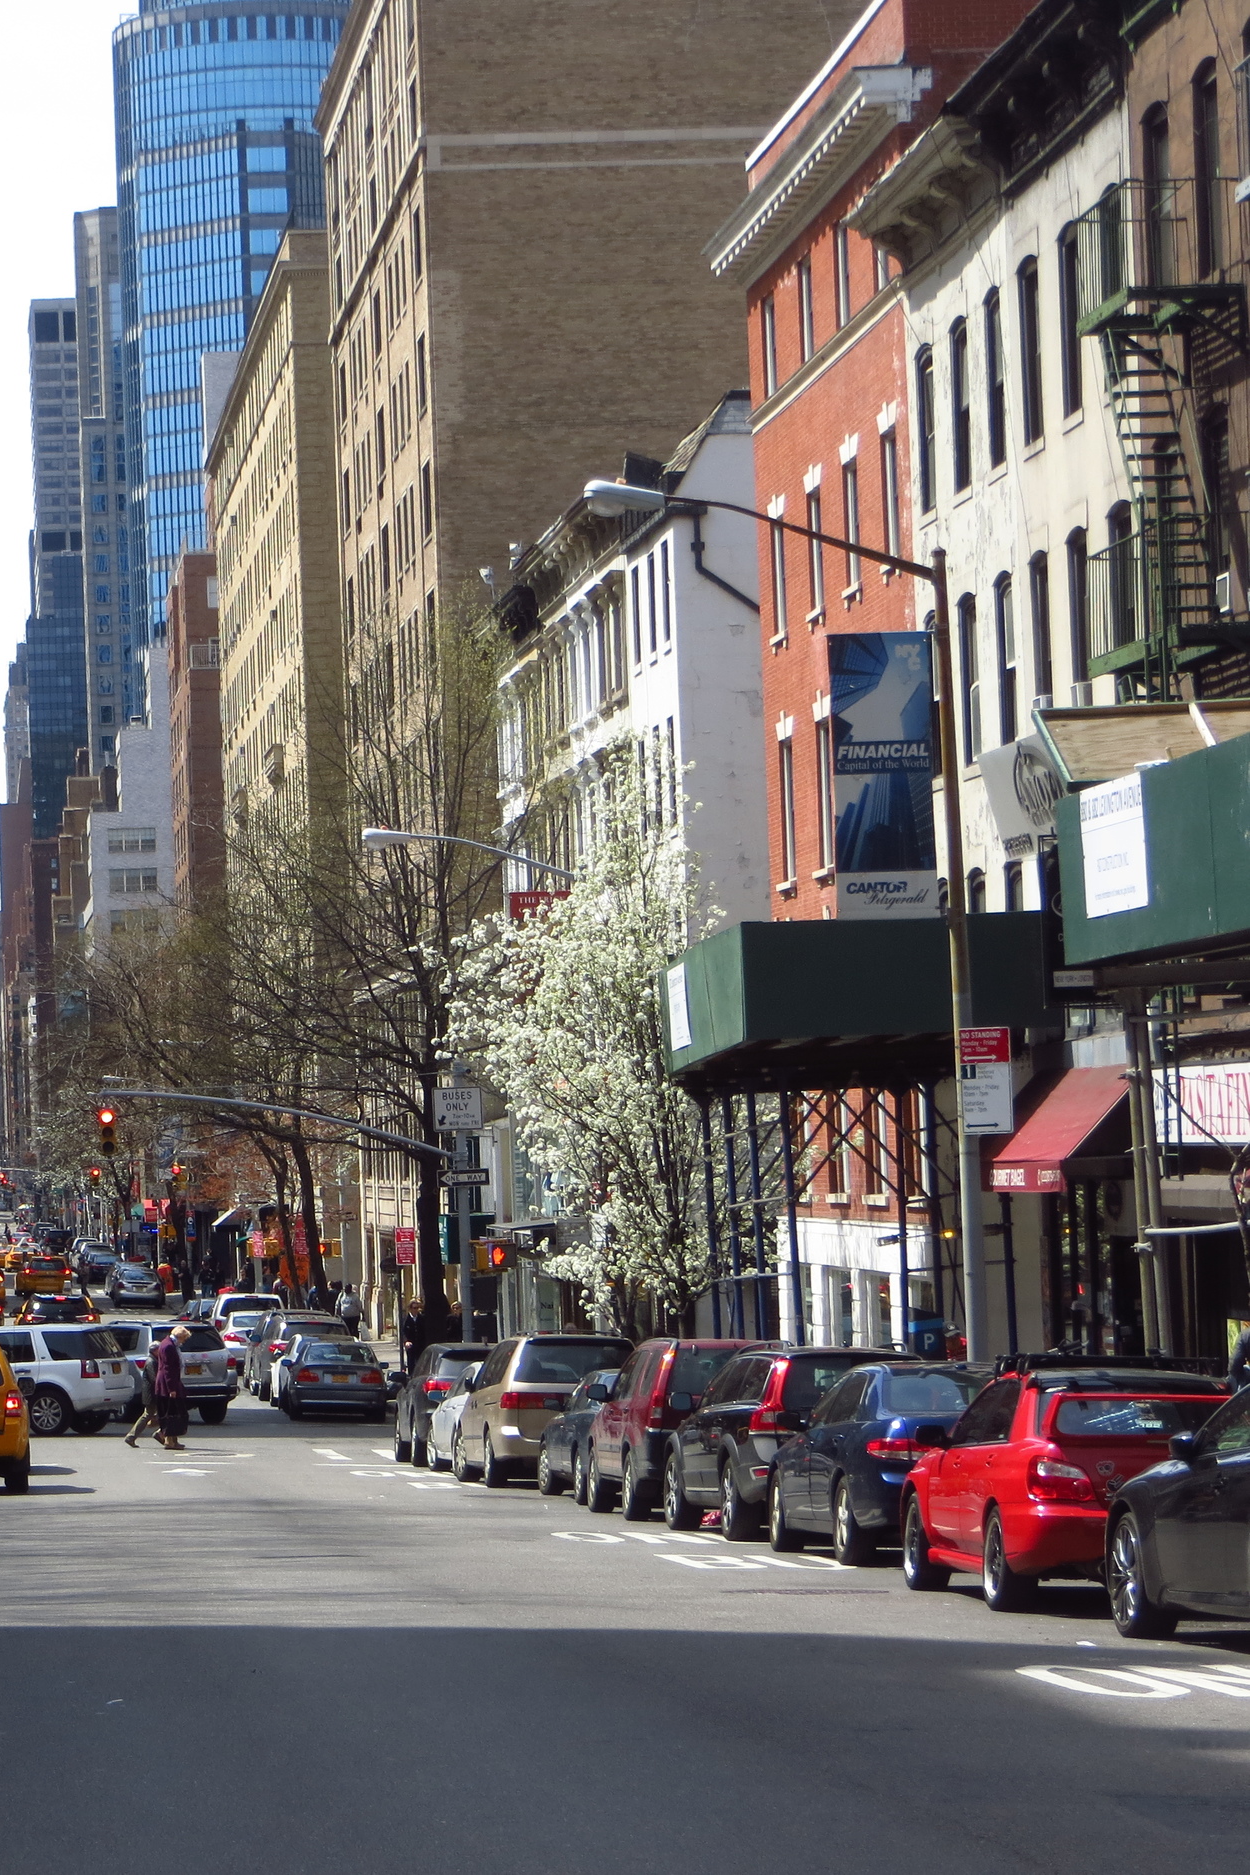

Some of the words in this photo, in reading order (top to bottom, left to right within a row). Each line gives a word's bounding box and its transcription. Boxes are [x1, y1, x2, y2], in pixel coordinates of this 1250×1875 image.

[837, 743, 928, 760] FINANCIAL
[837, 760, 870, 771] Capital
[872, 760, 882, 770] of
[885, 760, 899, 769] the
[902, 758, 929, 768] World
[846, 881, 908, 894] CANTOR
[863, 888, 929, 910] Fitzgerald
[960, 1032, 970, 1040] NO
[971, 1030, 1001, 1039] STANDING
[442, 1091, 472, 1101] BUSES
[445, 1102, 469, 1112] ONLY
[445, 1174, 460, 1182] ONE
[466, 1173, 482, 1181] WAY
[924, 1333, 935, 1350] P
[653, 1553, 858, 1571] BU
